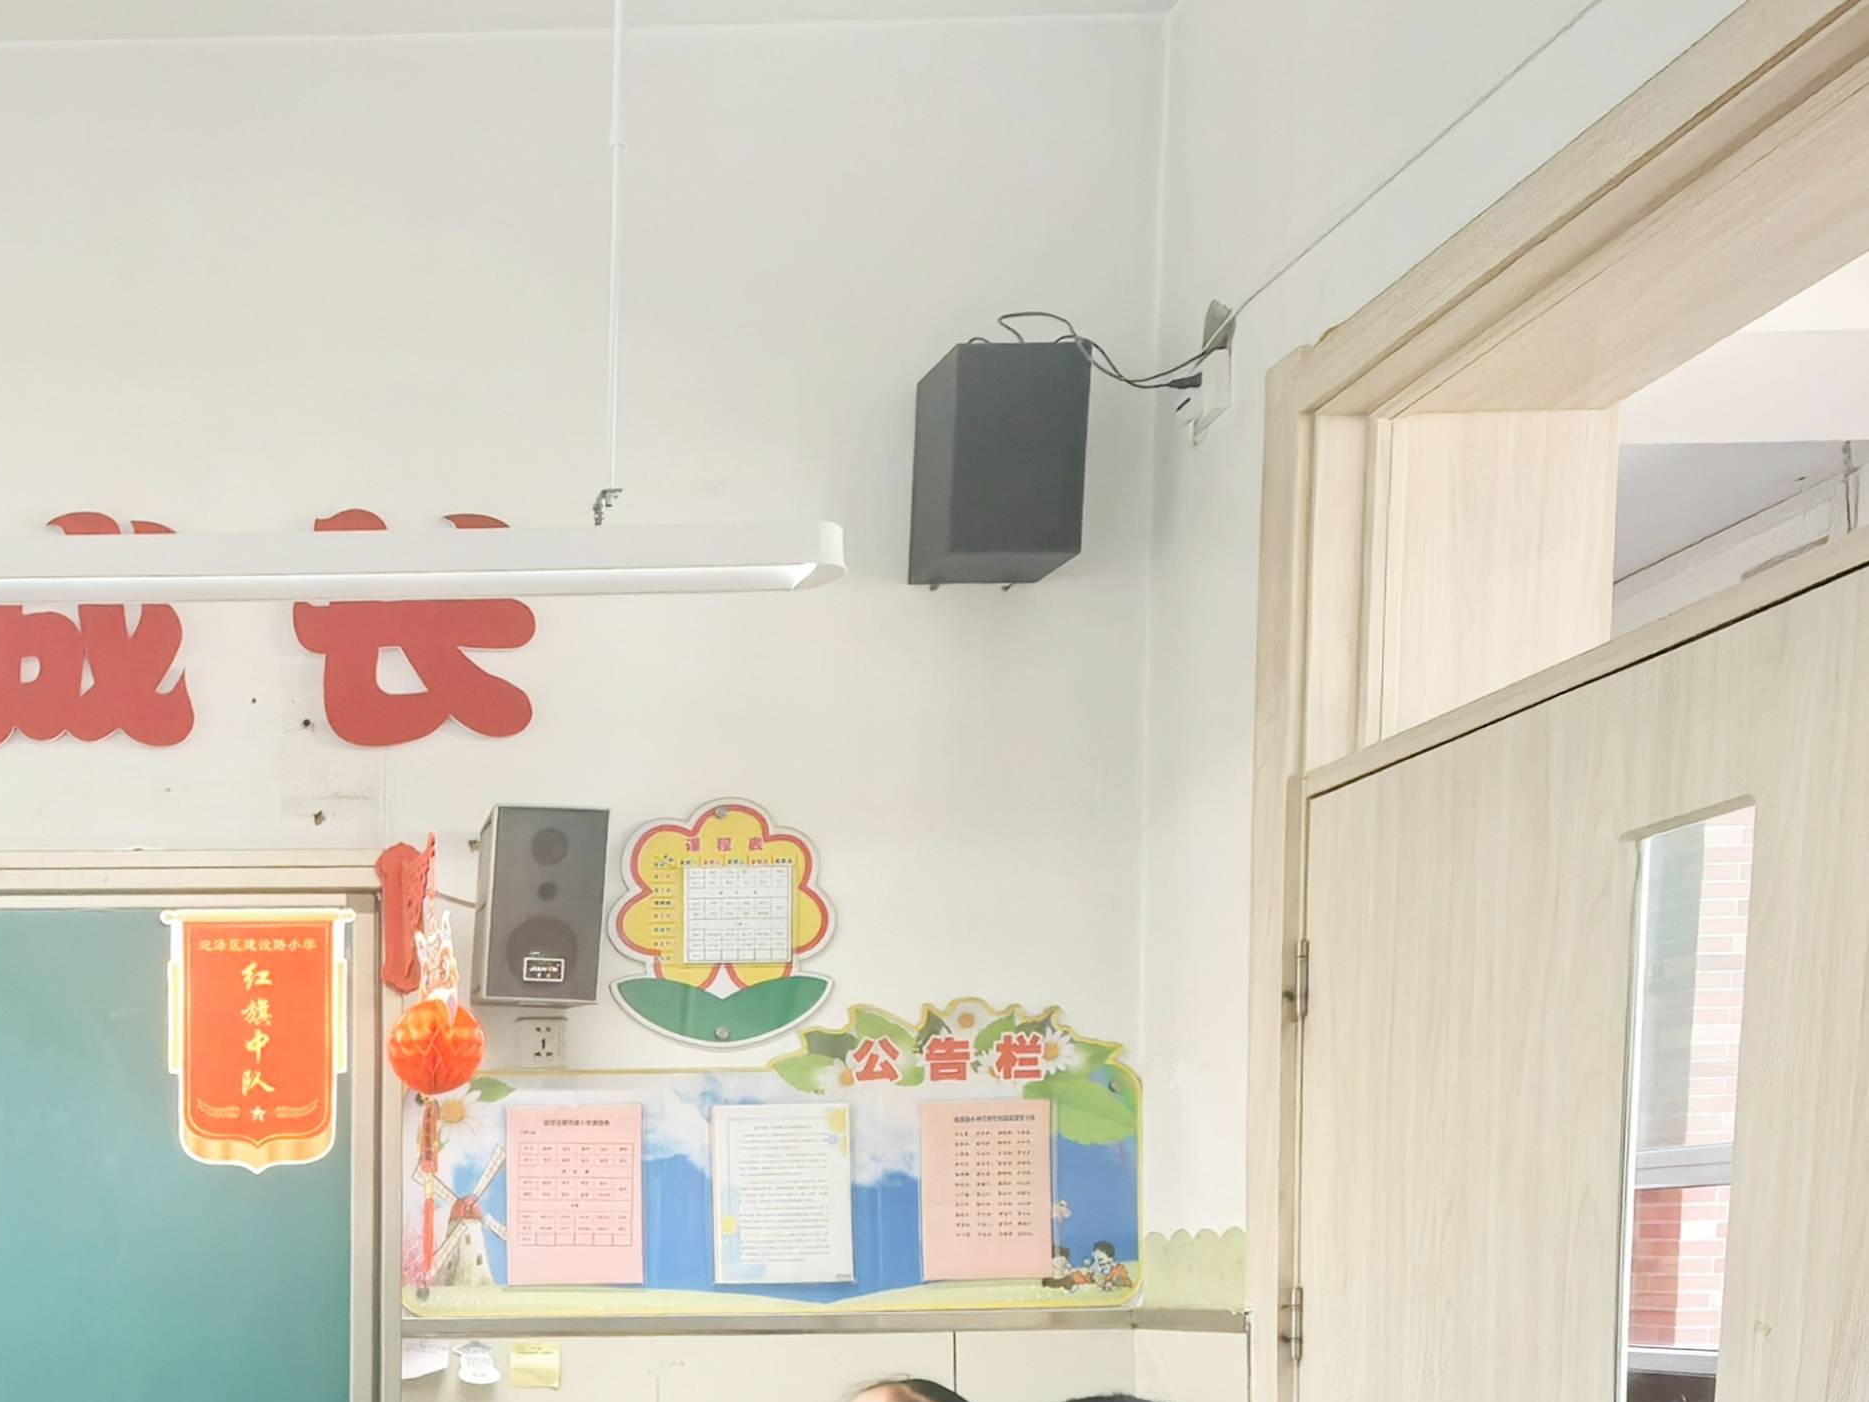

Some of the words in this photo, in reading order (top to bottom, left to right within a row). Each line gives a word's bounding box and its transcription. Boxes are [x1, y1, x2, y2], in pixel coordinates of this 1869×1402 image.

[241, 962, 275, 1096] 红旗中队
[852, 1034, 1043, 1082] 公告栏
